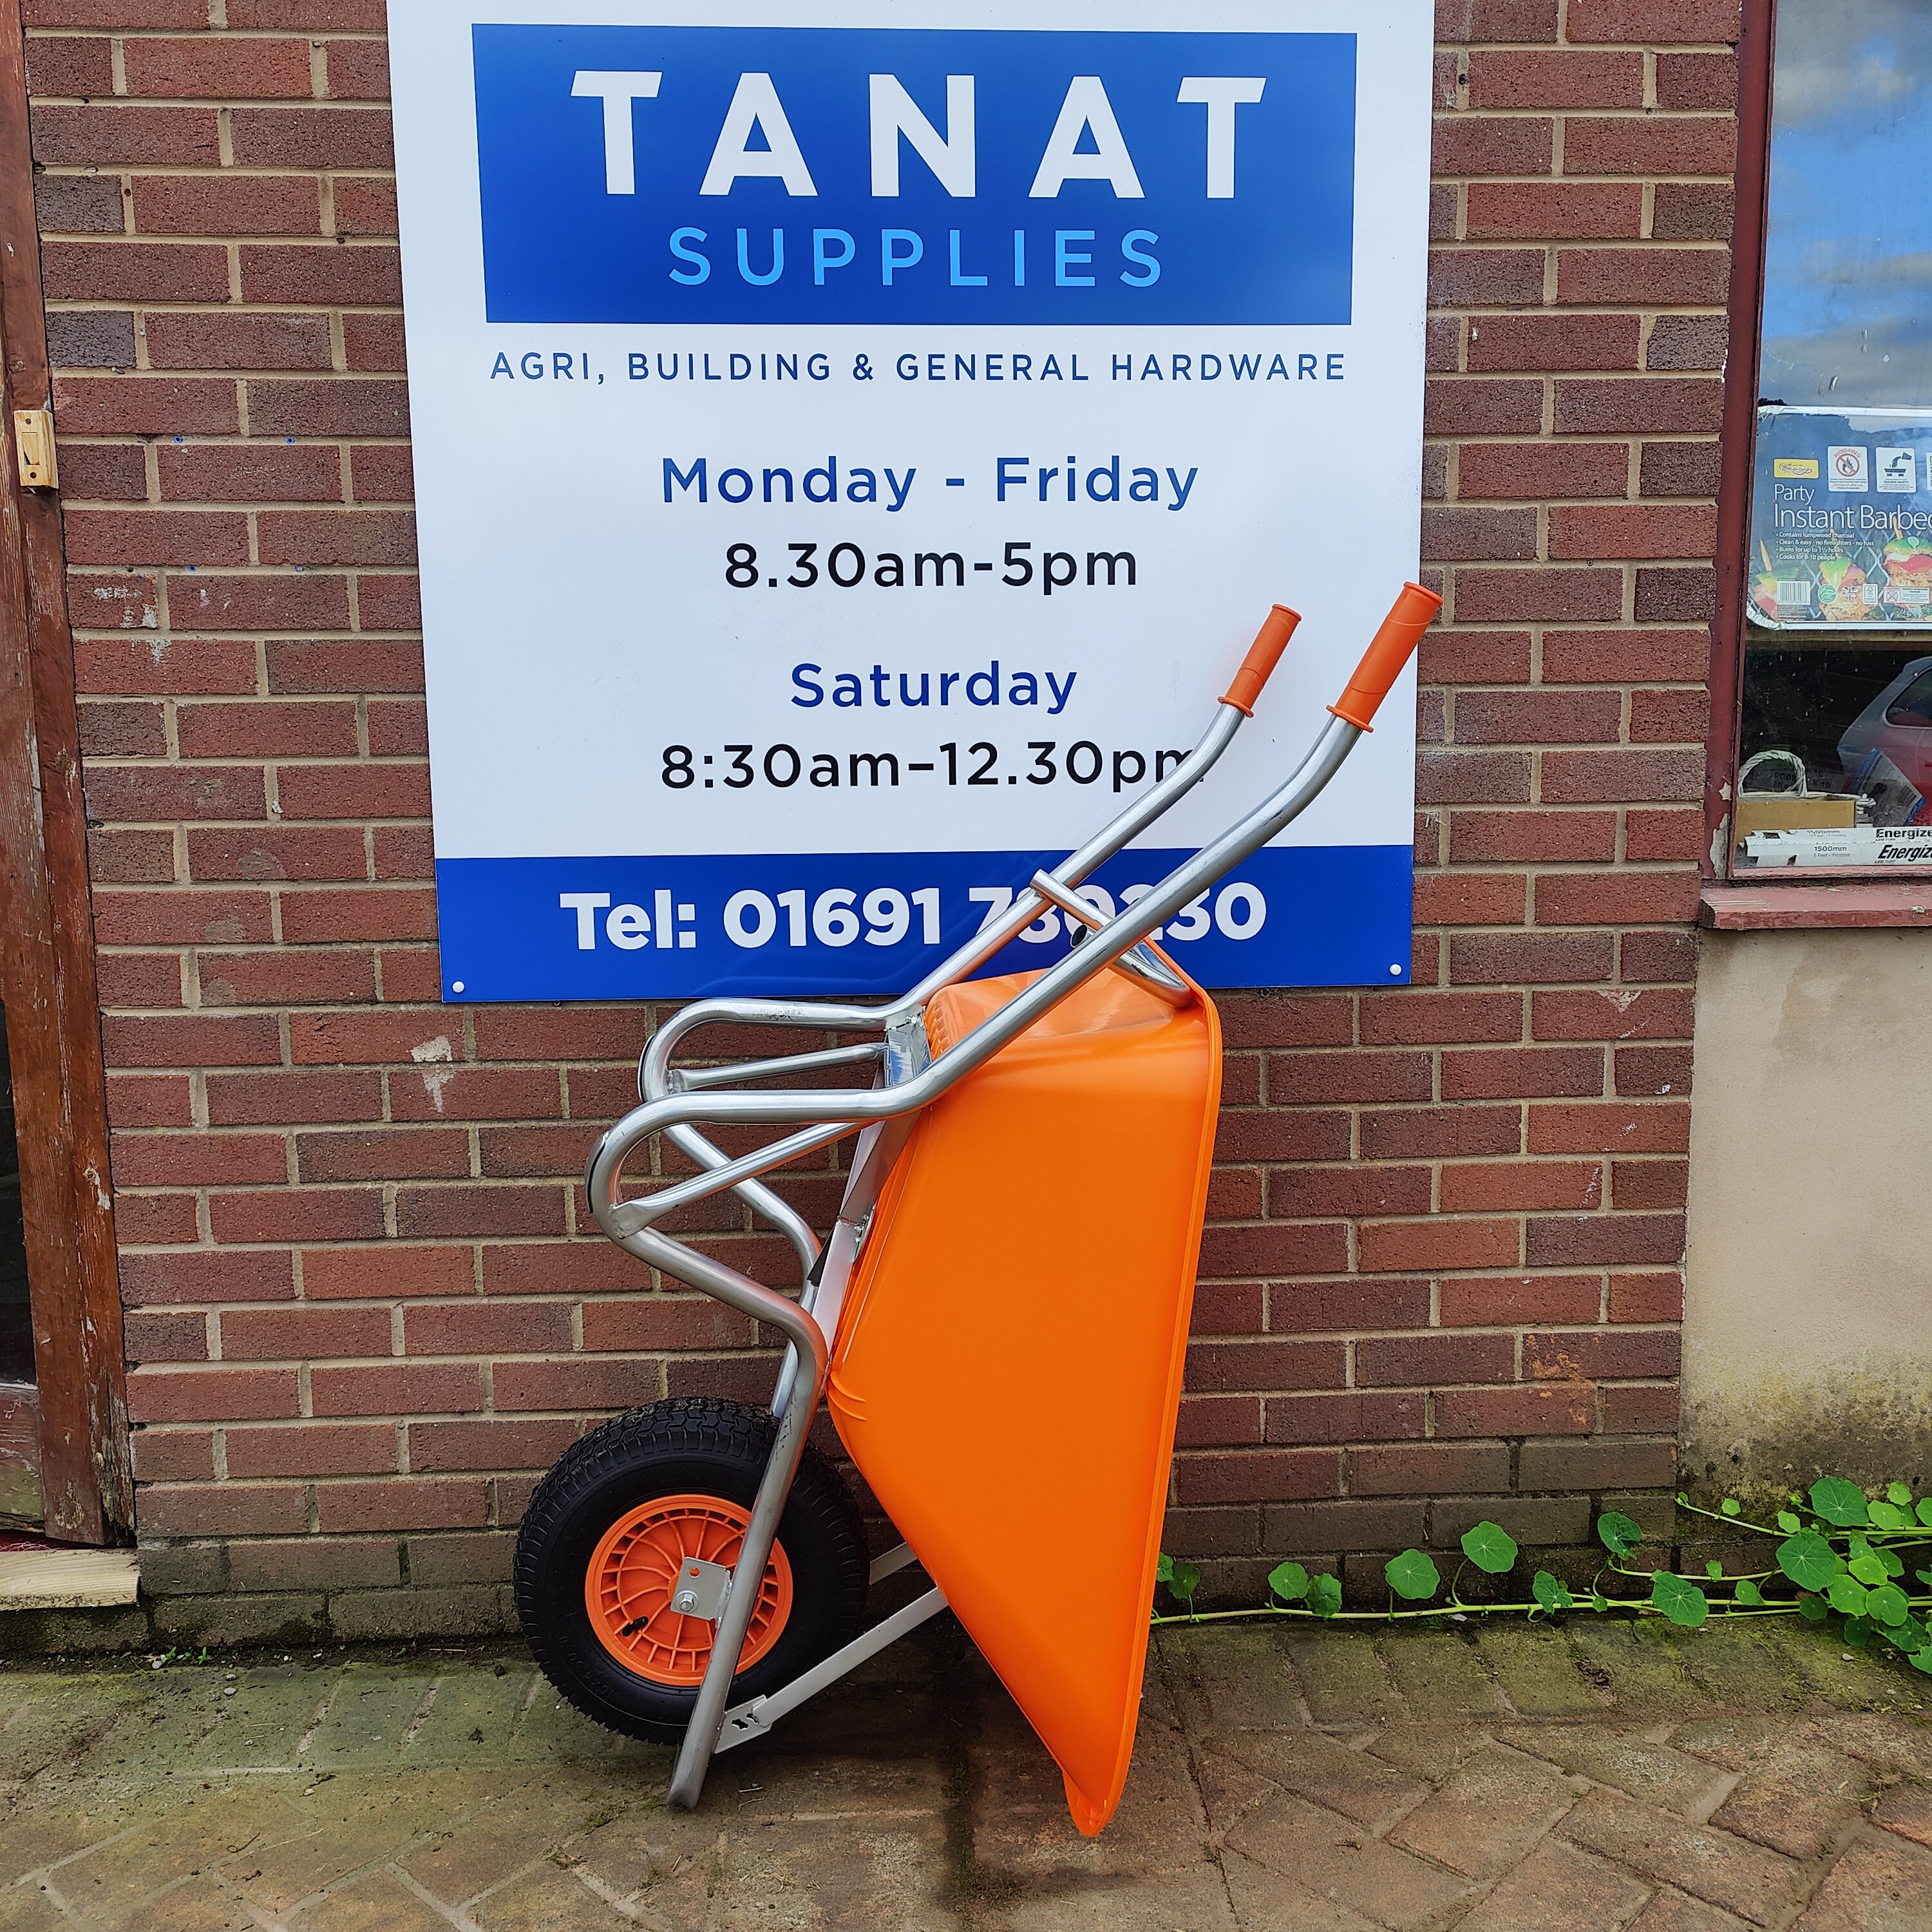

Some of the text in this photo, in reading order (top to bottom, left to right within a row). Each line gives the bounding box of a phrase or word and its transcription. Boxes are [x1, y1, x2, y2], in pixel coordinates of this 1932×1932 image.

[571, 71, 1266, 198] TANAT
[669, 227, 1161, 287] SUPPLIES
[491, 352, 1344, 384] AGRI, BUILDING & GENERAL HARDWARE
[663, 455, 916, 512] Monday
[997, 455, 1198, 511] Friday
[1774, 483, 1815, 506] Party
[1775, 504, 1855, 528] Instant
[726, 542, 1136, 596] 8.30am-5pm
[791, 661, 1077, 715] Saturday
[560, 890, 696, 949] Tel:
[724, 888, 940, 948] 01691
